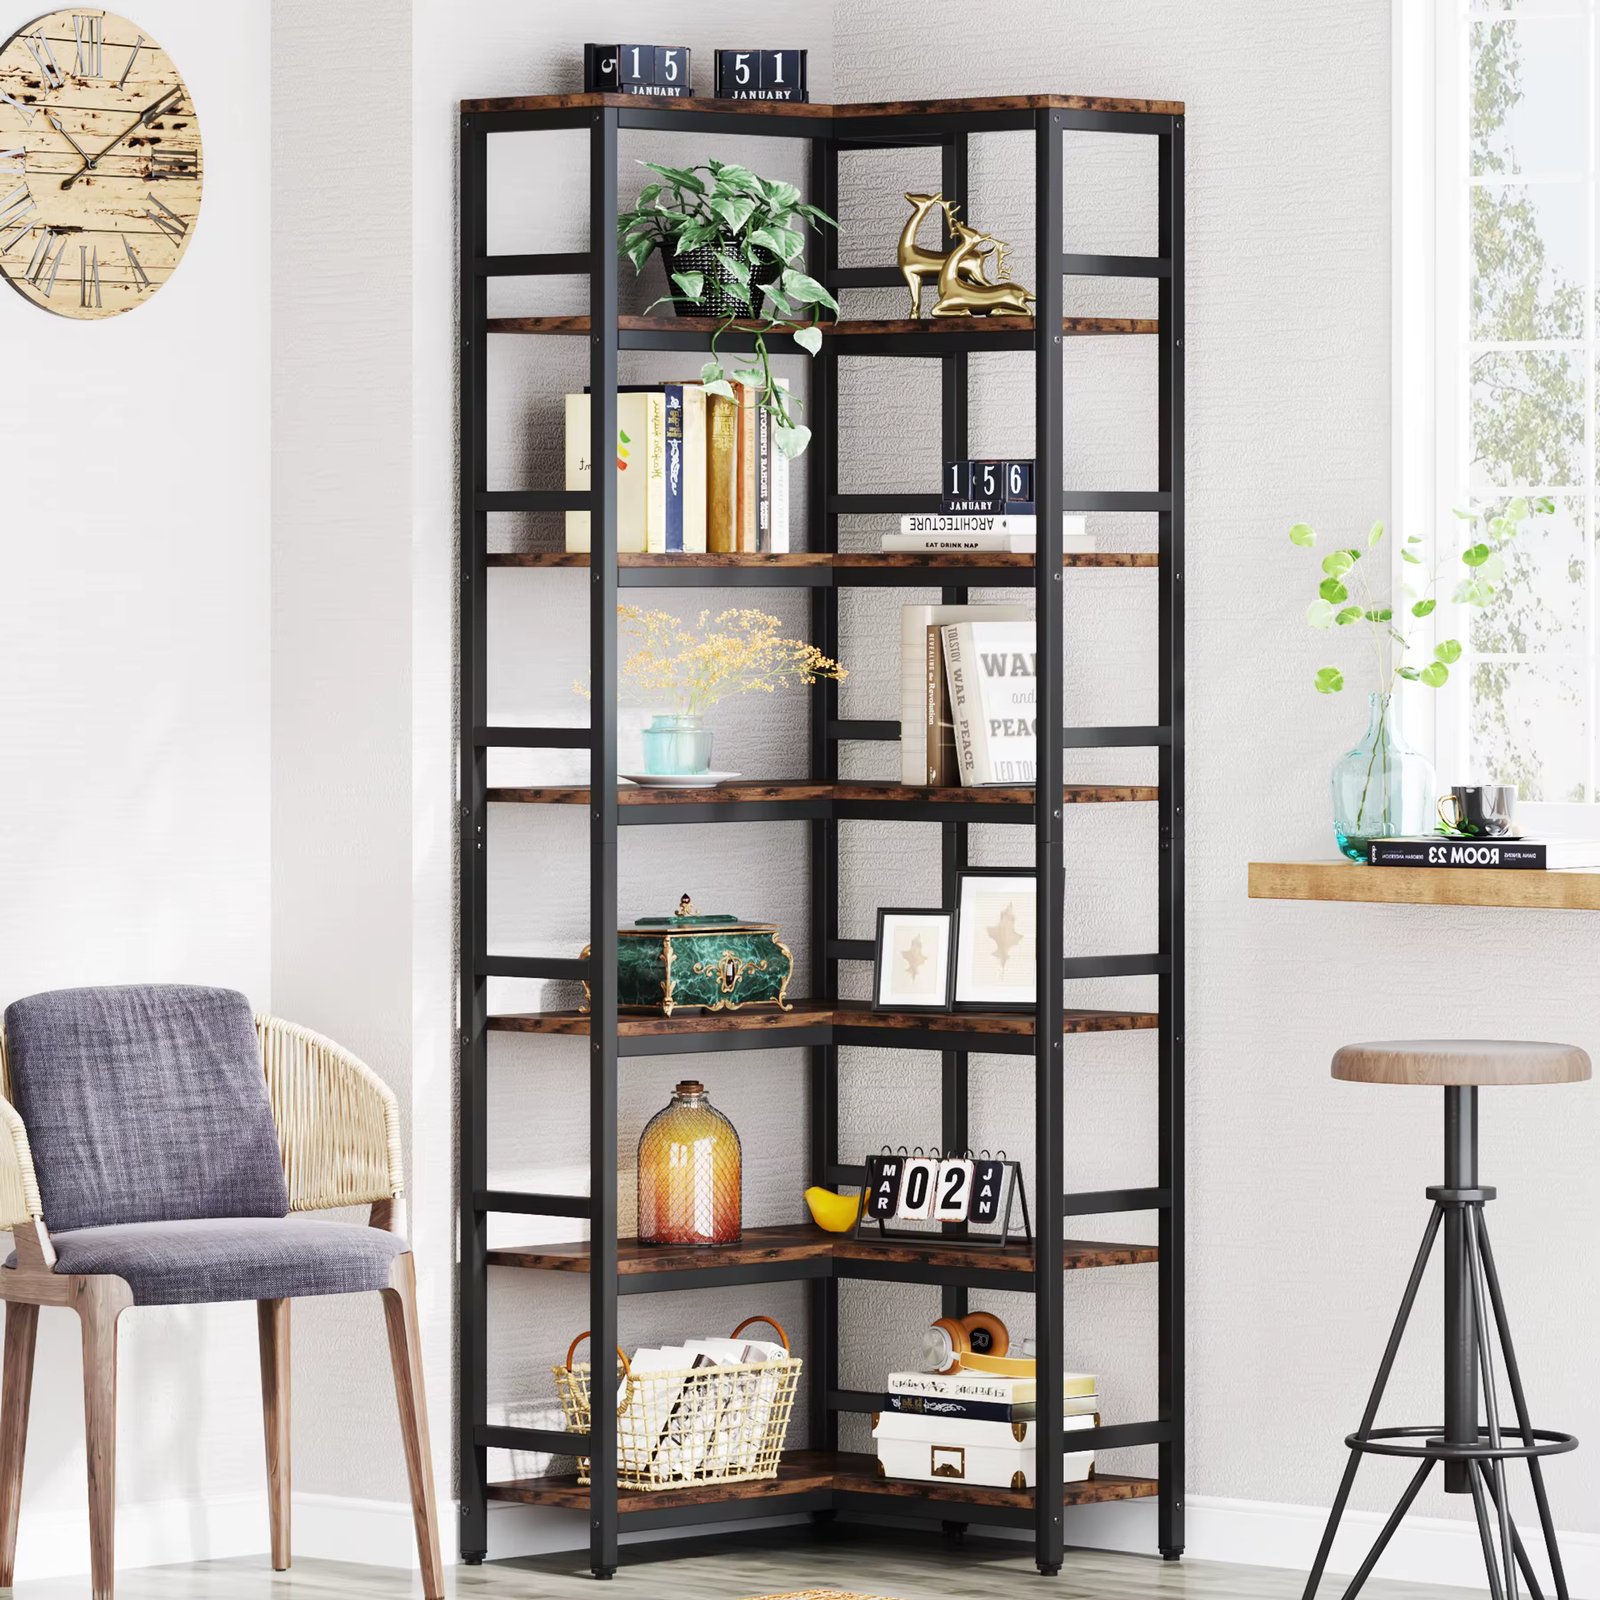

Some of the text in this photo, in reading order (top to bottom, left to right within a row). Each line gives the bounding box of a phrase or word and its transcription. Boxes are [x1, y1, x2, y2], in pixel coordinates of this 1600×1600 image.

[631, 85, 681, 97] JANUARY
[732, 90, 791, 100] JANUARY
[949, 501, 993, 511] JANUARY
[909, 517, 994, 531] ARCHITECTURE
[928, 683, 936, 725] Revolution
[947, 627, 974, 771] TOLSTOY WAR PEACE
[1012, 688, 1035, 704] and
[994, 761, 1014, 782] LEO
[877, 1164, 897, 1210] MAR
[979, 1168, 993, 1214] JAN
[972, 1332, 989, 1347] R
